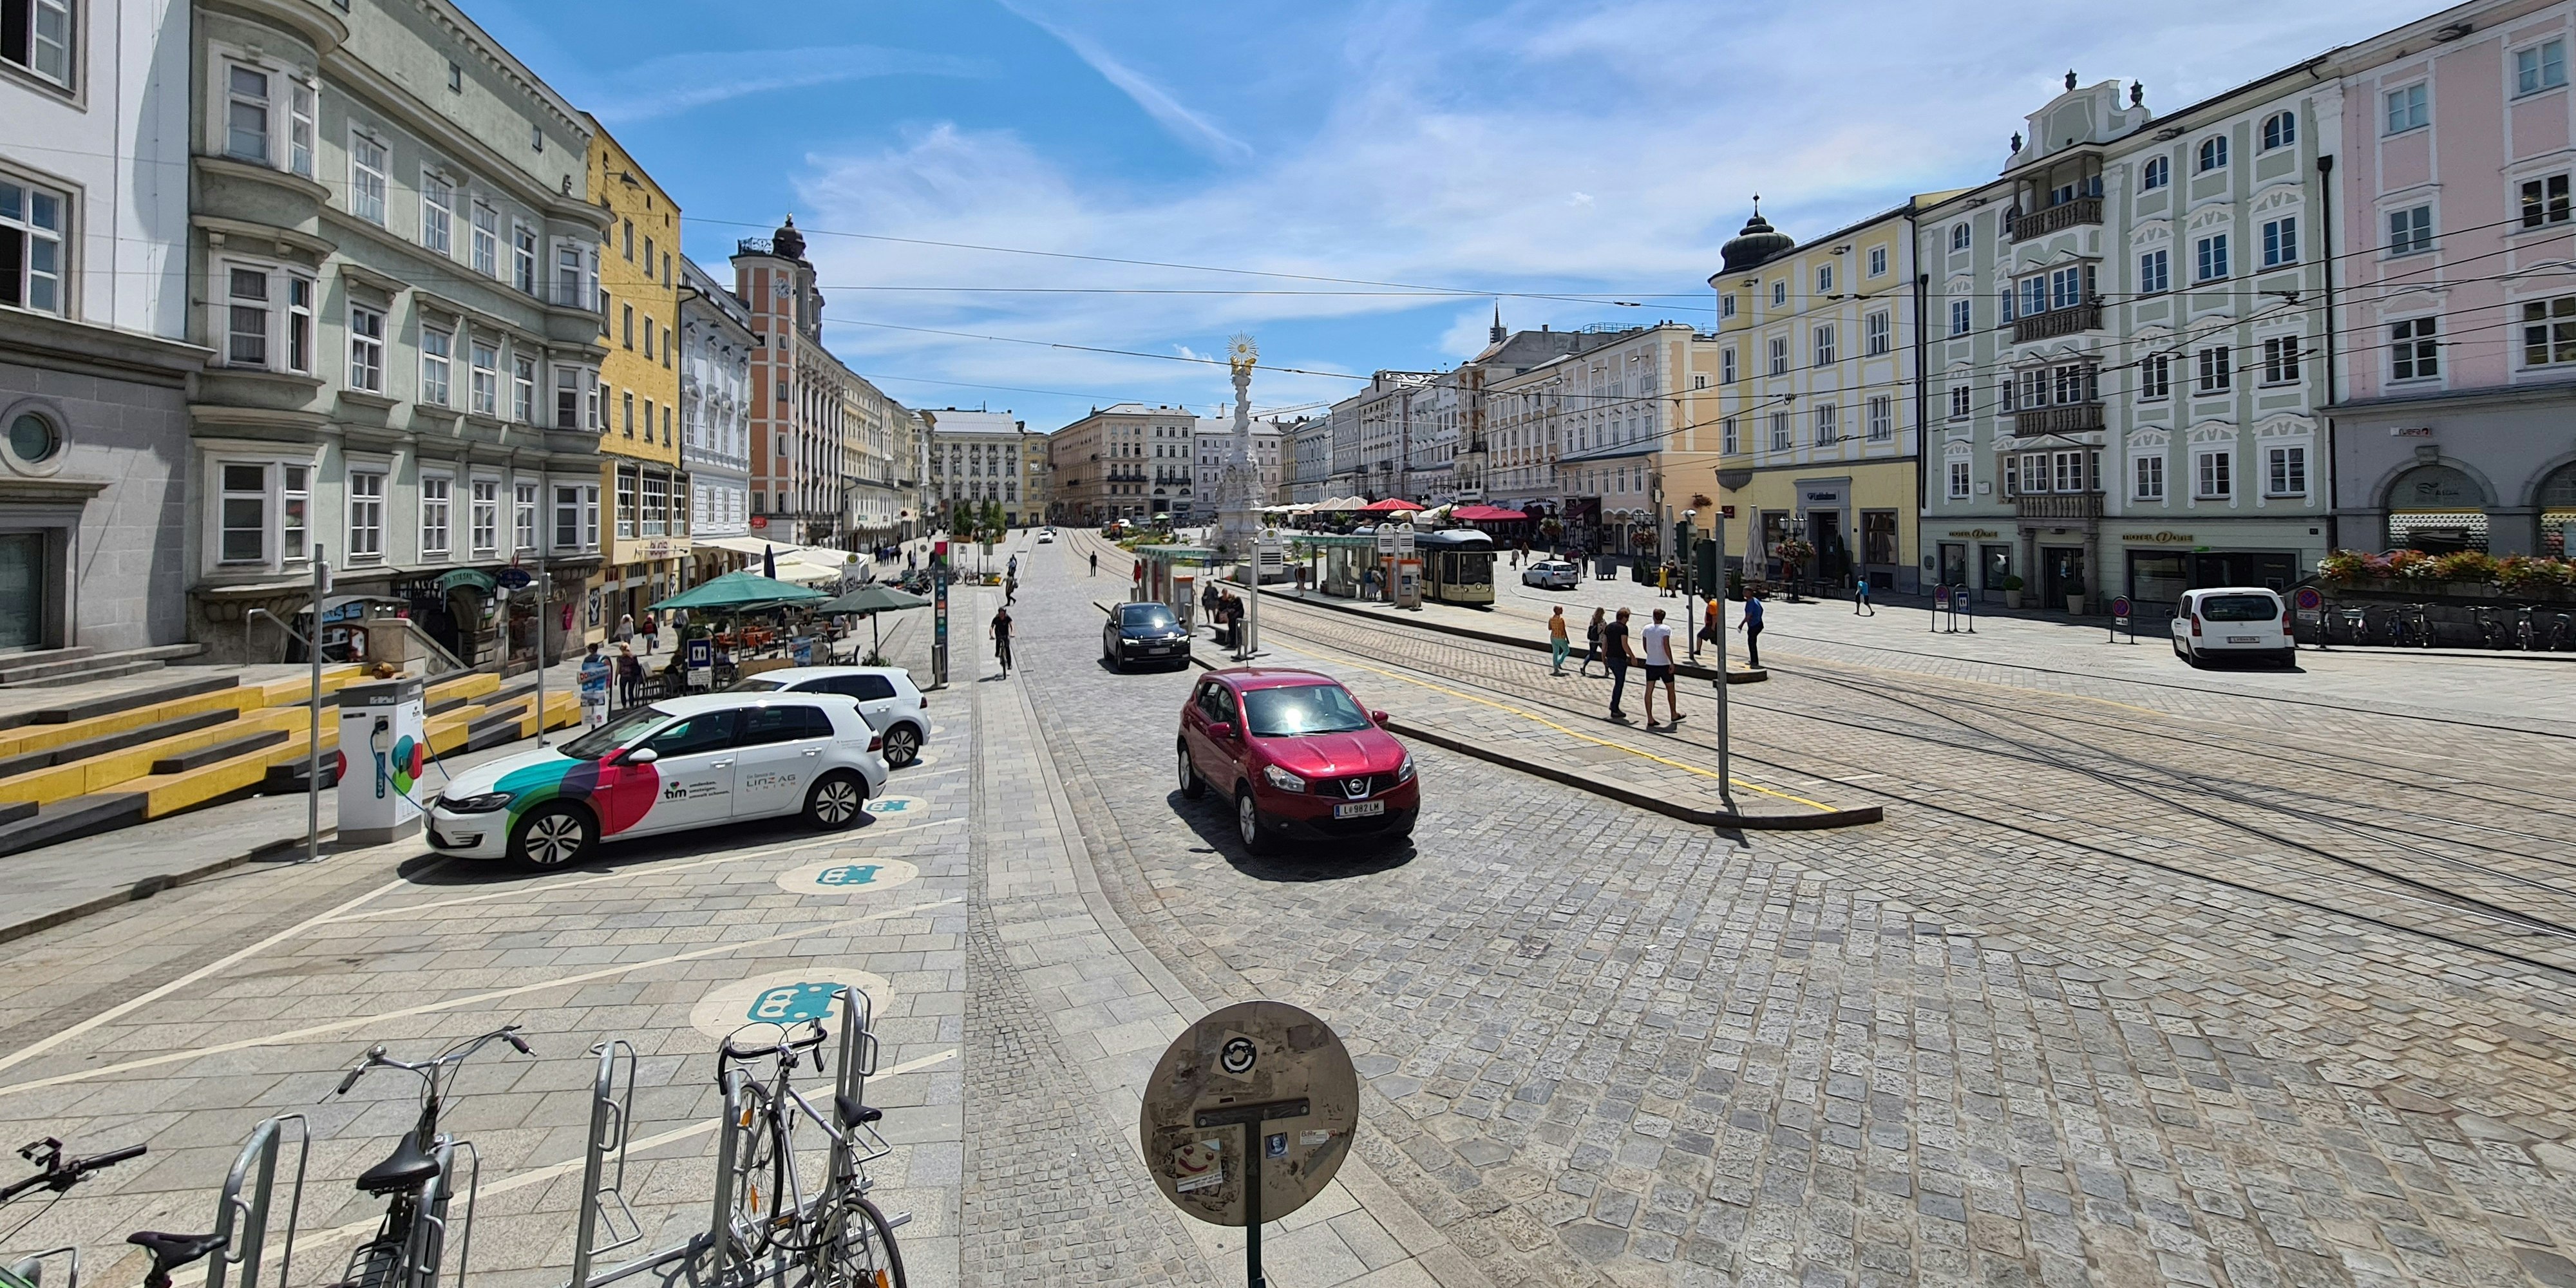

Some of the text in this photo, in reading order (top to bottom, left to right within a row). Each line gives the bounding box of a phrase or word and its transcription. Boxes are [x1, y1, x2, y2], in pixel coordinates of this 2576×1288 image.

[746, 774, 796, 787] LINZ AG
[664, 788, 687, 799] tim
